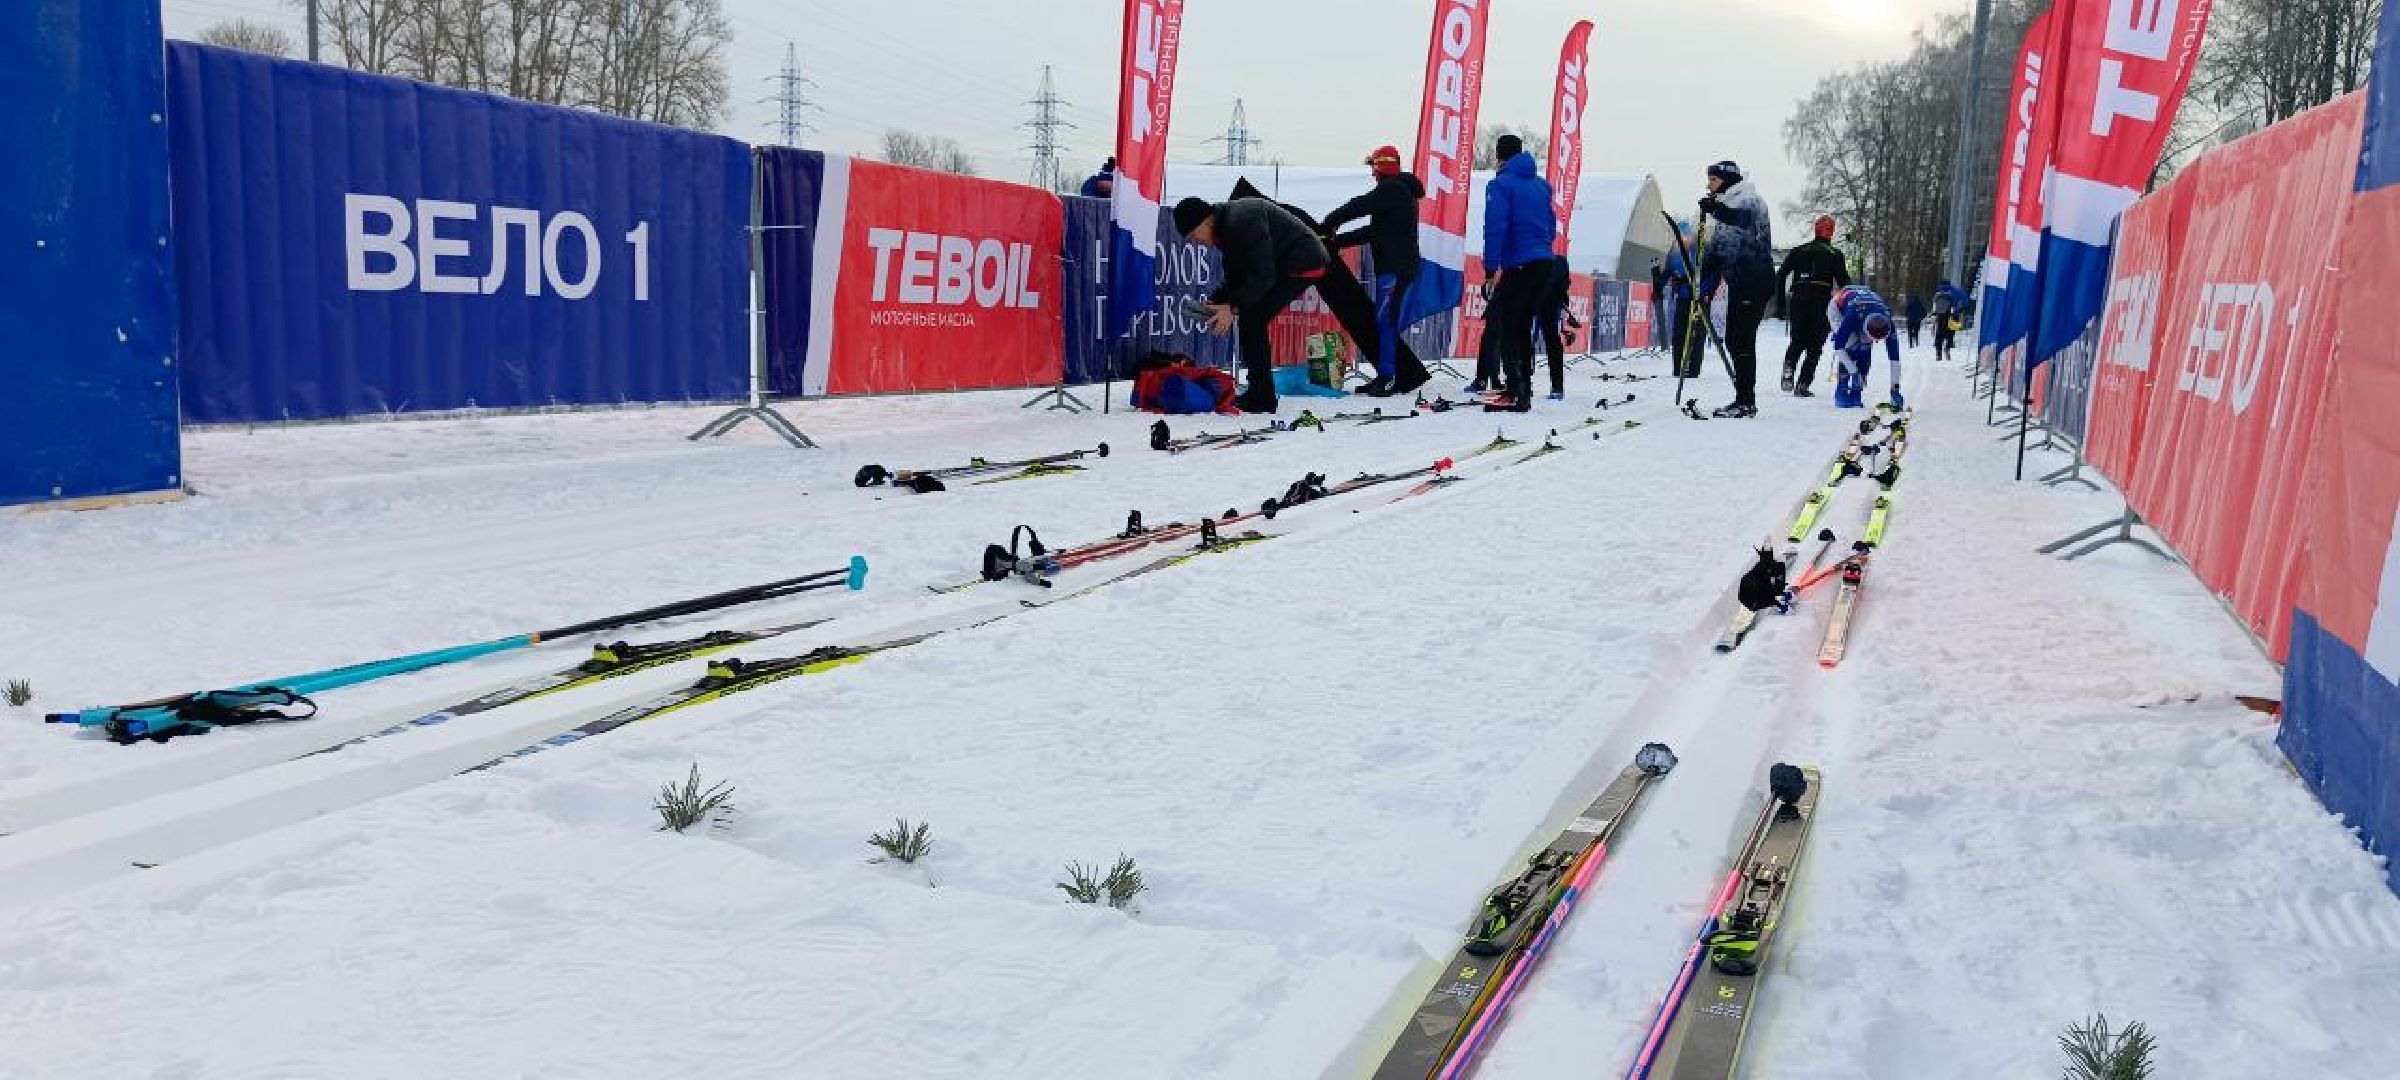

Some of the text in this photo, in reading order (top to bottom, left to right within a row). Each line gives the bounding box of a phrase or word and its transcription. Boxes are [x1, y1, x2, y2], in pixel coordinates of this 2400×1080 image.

[345, 193, 649, 300] ВЕЛО 1
[868, 227, 1040, 309] TEBOIL
[870, 310, 976, 328] МОТОРНЫЕ МАСЛА
